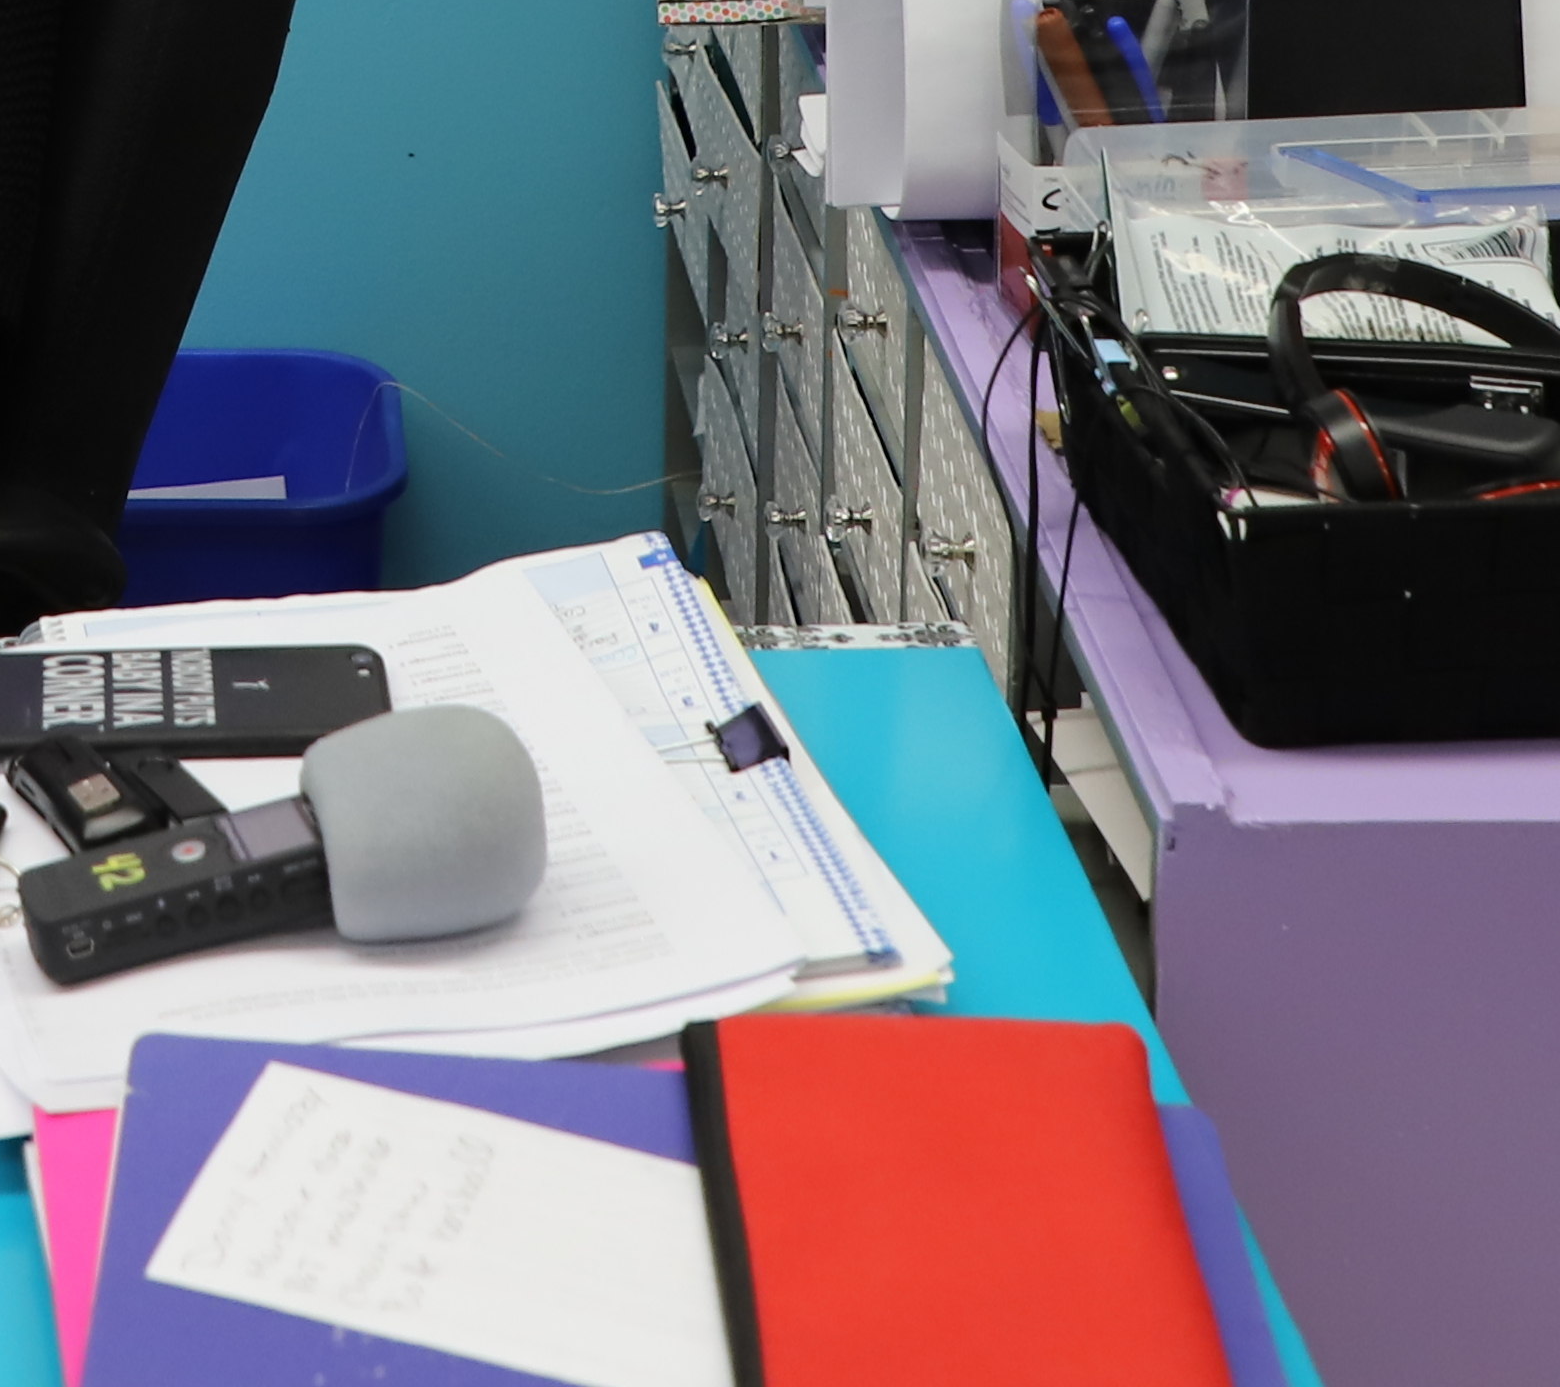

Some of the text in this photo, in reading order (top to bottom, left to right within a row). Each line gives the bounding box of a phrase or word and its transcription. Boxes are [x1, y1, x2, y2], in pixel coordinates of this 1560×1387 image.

[112, 651, 165, 728] BABY IN A
[171, 650, 216, 727] NOBODY PUTS
